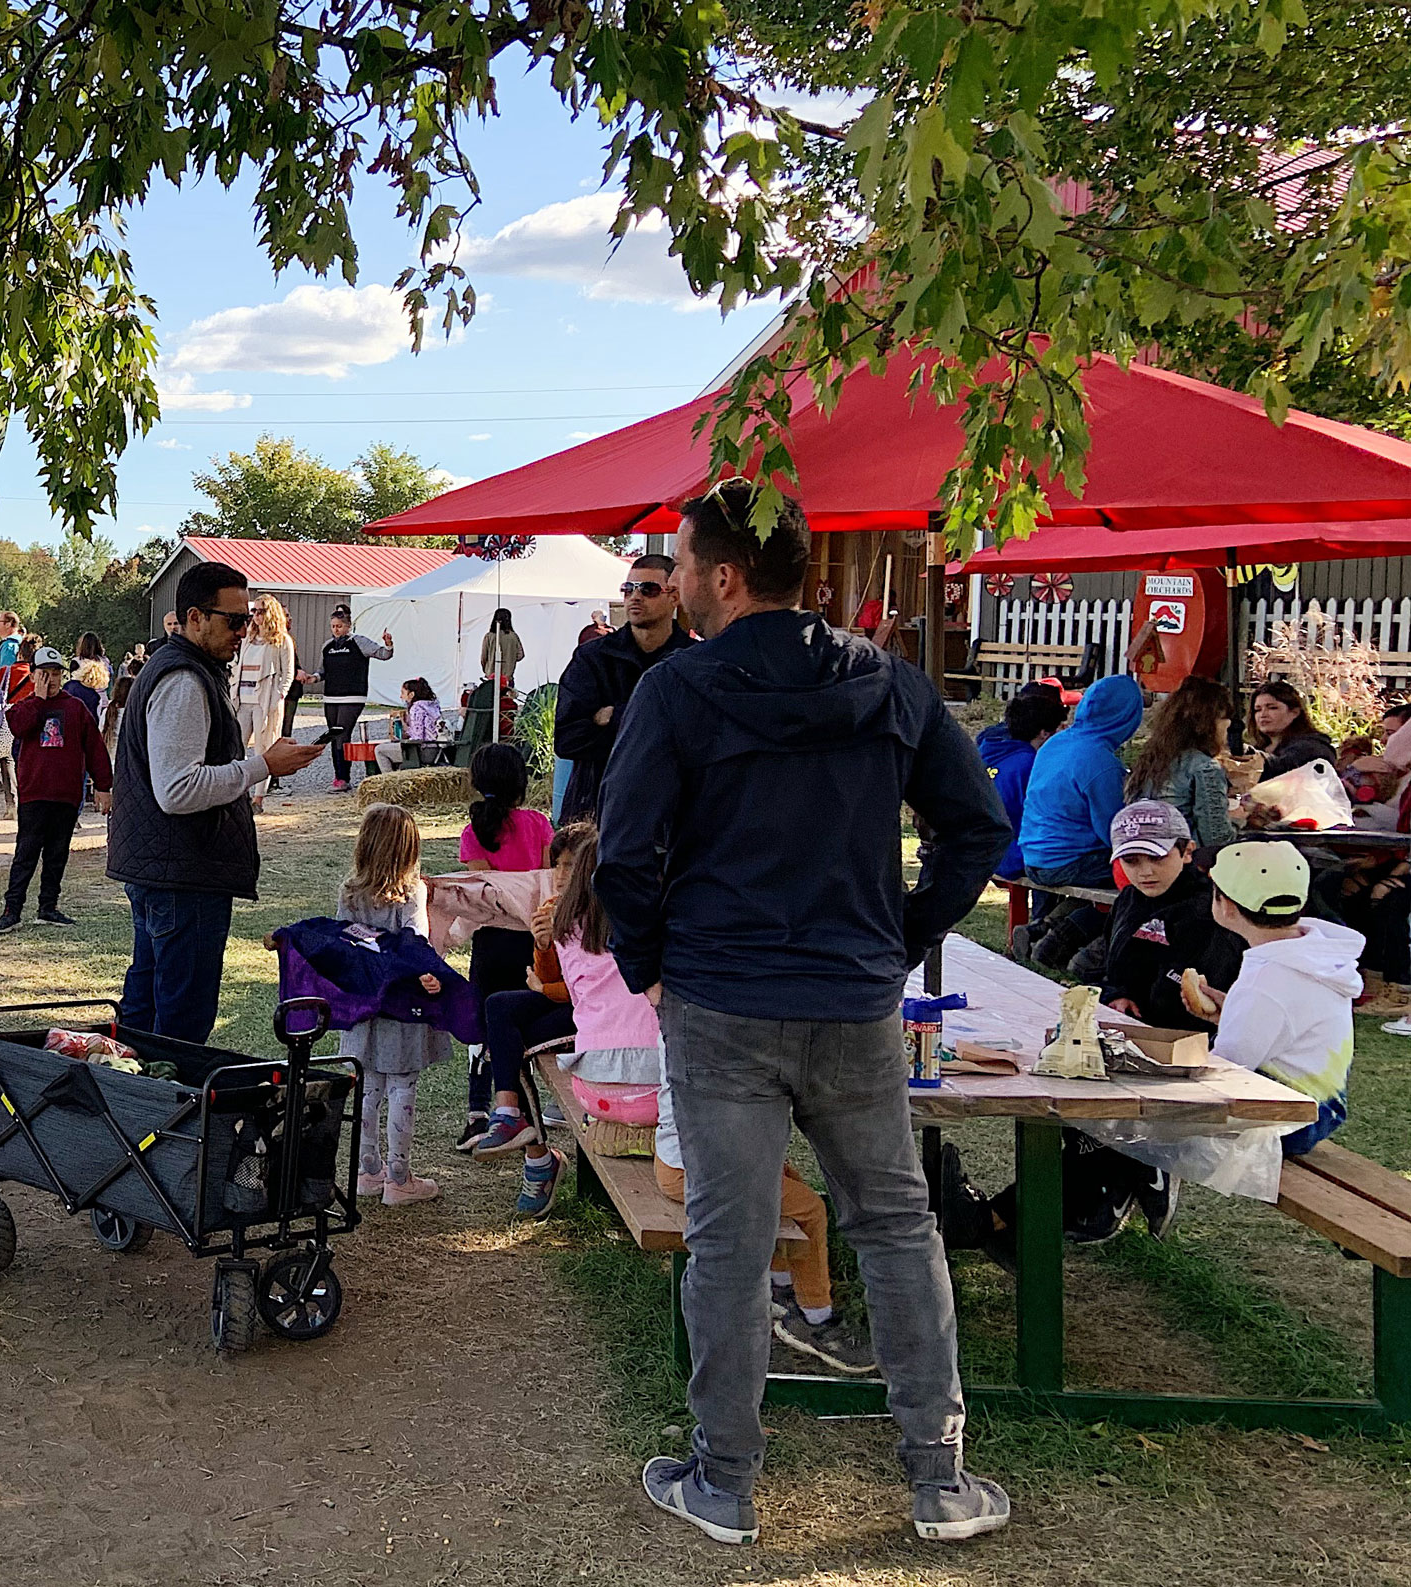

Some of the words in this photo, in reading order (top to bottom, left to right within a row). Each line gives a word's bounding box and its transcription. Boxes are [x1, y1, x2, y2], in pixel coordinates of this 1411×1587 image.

[1147, 577, 1191, 586] MOUNTAIN
[1146, 586, 1192, 595] ORCHARDS
[47, 651, 57, 660] C
[908, 1023, 937, 1033] SAVARD
